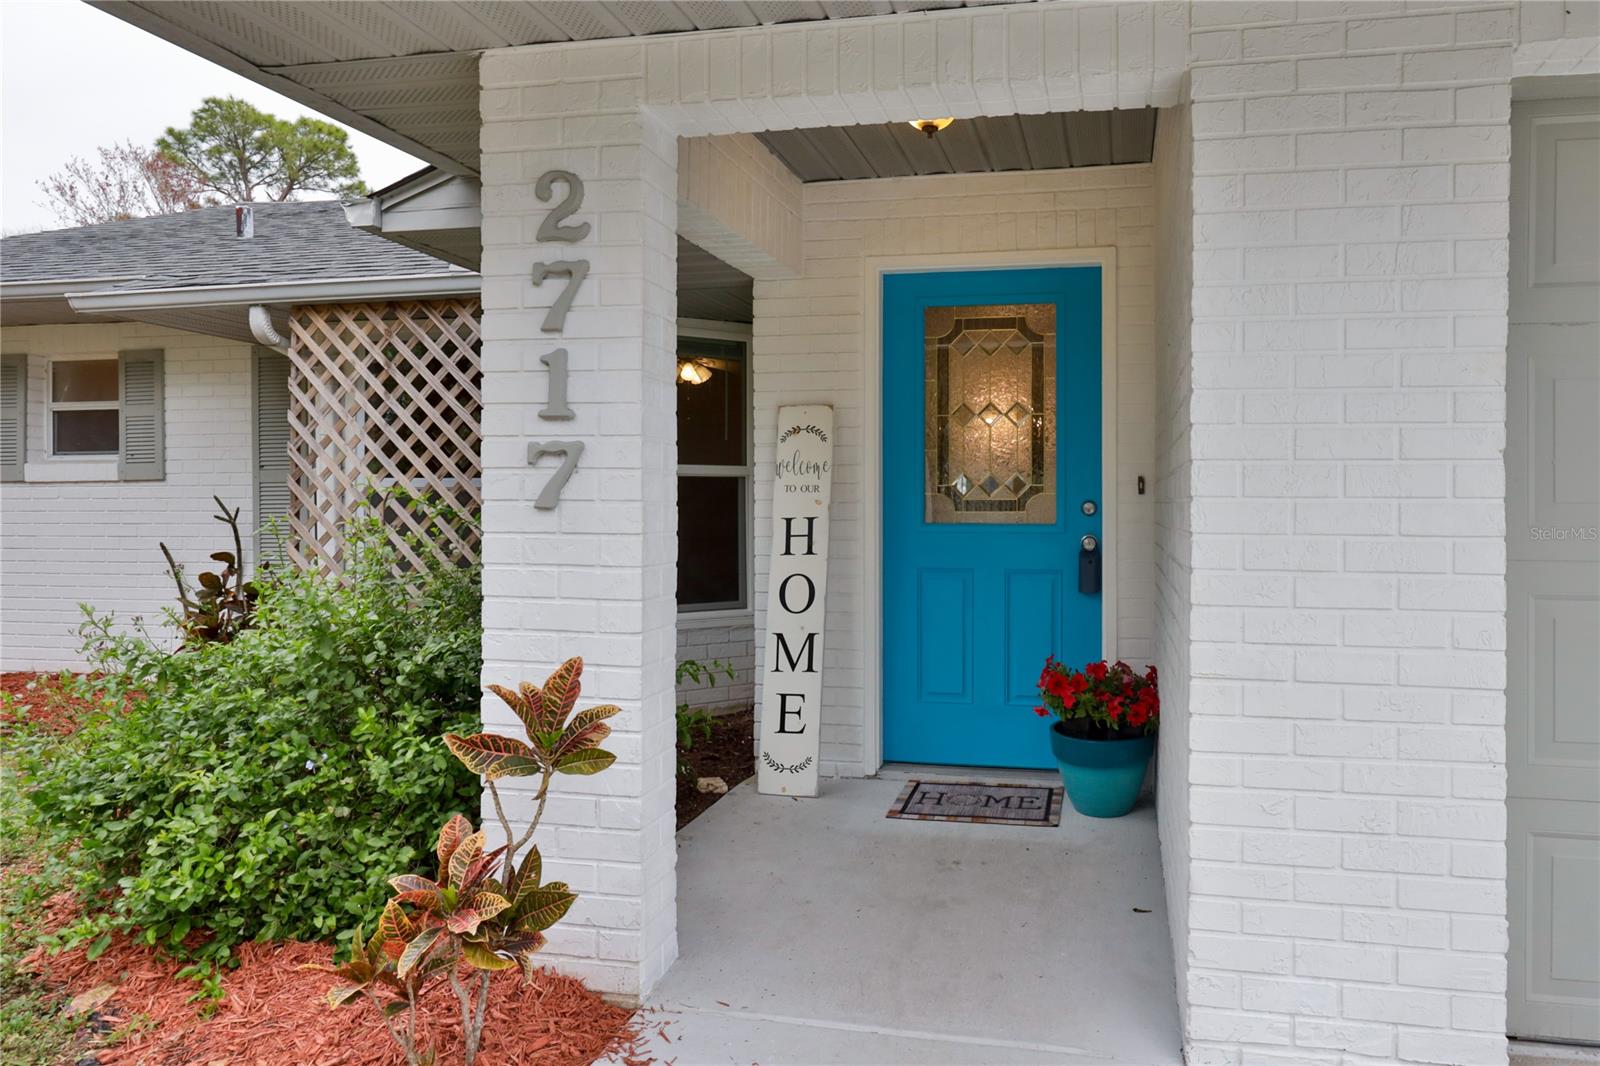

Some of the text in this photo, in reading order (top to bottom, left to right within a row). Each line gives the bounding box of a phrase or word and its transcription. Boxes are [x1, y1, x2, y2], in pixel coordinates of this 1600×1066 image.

[527, 169, 592, 511] 2717
[776, 449, 831, 480] welcome
[784, 484, 820, 493] TO OUR
[770, 516, 819, 735] HOME
